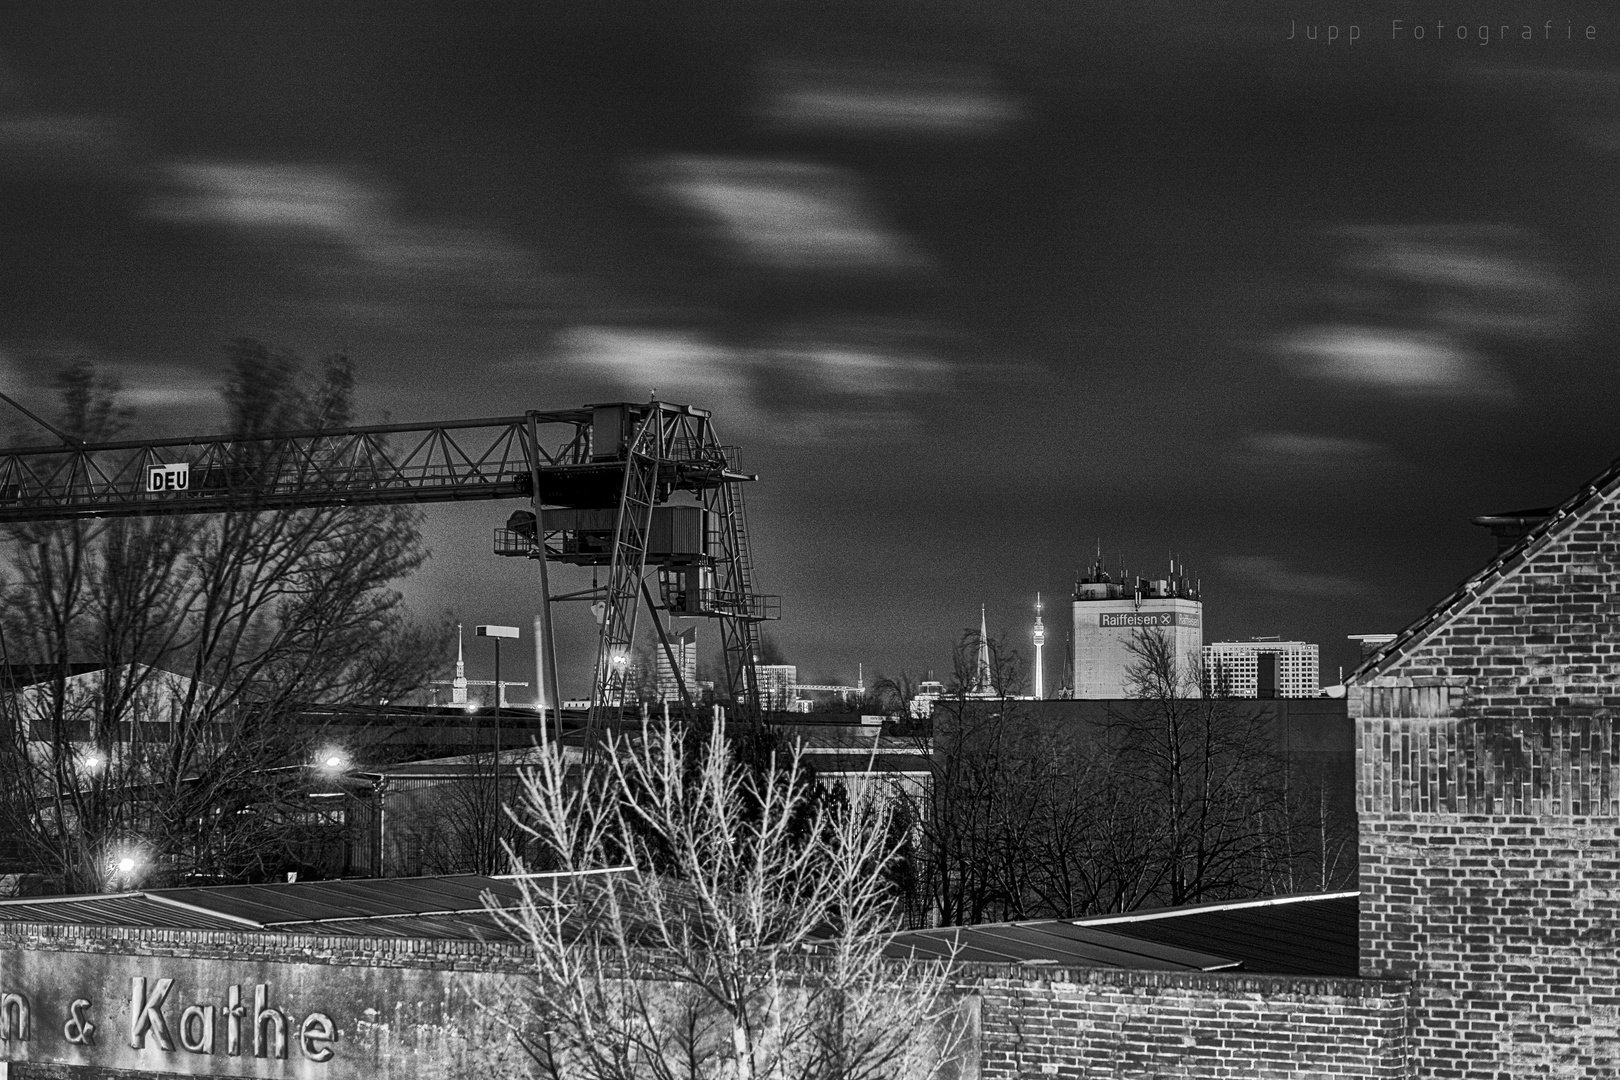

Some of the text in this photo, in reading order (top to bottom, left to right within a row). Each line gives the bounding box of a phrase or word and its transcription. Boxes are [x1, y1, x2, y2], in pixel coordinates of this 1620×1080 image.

[153, 471, 187, 490] DEU
[1102, 614, 1158, 626] Raiffeisen
[64, 999, 96, 1046] &
[130, 977, 338, 1062] Kathe
